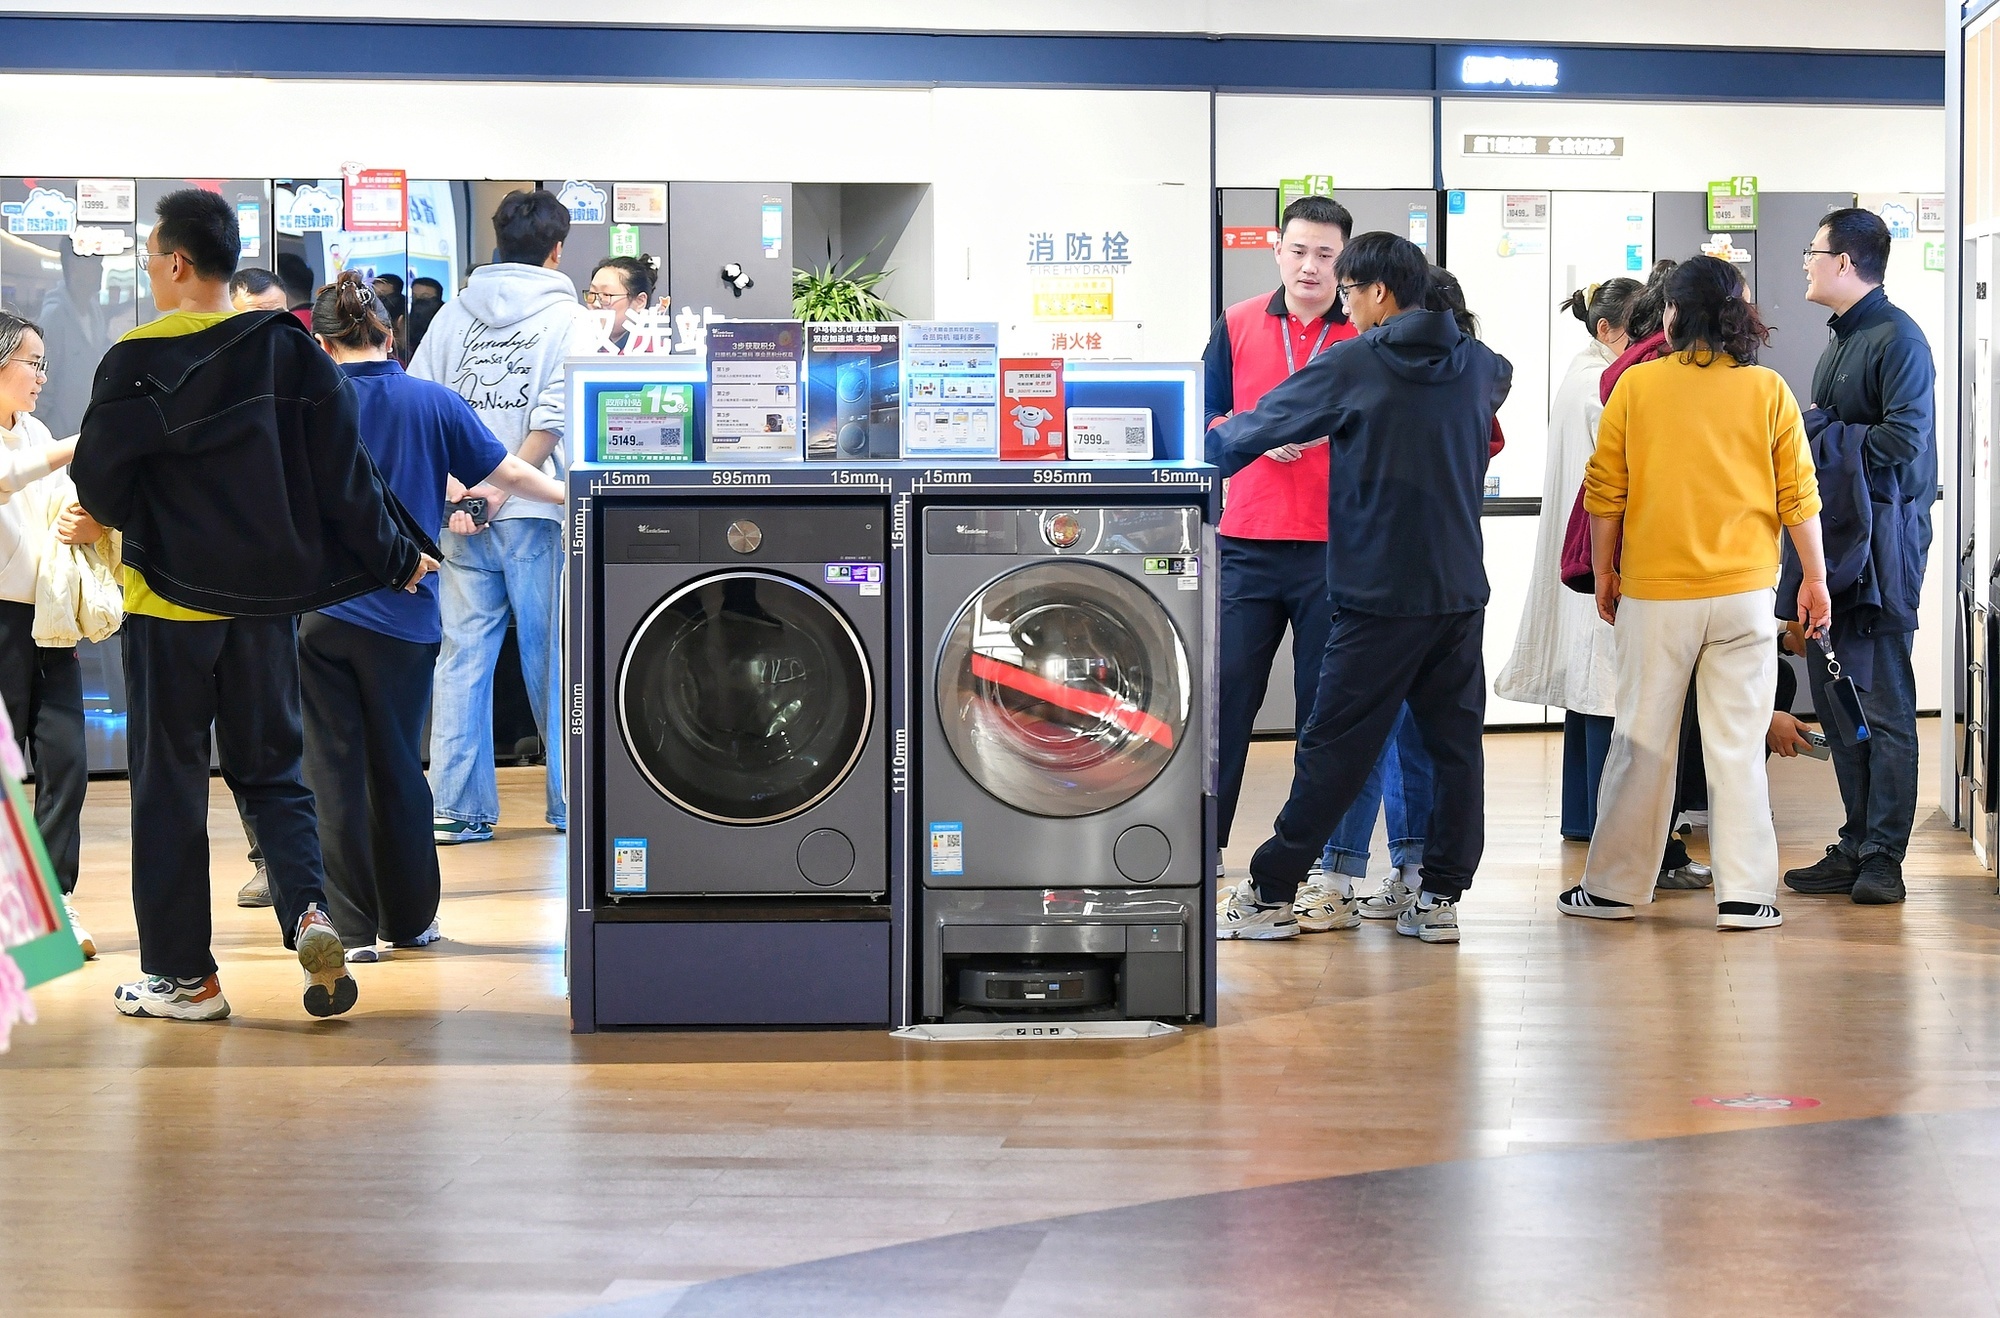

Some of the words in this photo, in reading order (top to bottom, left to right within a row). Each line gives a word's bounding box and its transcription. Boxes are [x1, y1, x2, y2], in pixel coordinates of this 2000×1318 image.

[1408, 202, 1428, 211] Midea
[294, 214, 334, 228] 熊墩墩
[1028, 231, 1129, 261] 消防栓
[1030, 264, 1060, 275] FIRE
[1064, 264, 1128, 275] HYDRANT
[922, 333, 951, 341] 会员购机
[952, 333, 981, 341] 福利多多
[1052, 332, 1102, 350] 消火栓
[732, 342, 776, 350] 3步获取积分
[605, 398, 642, 407] 政府补贴
[647, 386, 689, 413] 15%
[602, 471, 650, 485] 15mm
[712, 471, 771, 485] 595mm
[831, 470, 879, 484] 15mm
[924, 470, 972, 484] 15mm
[1033, 470, 1092, 484] 595mm
[1151, 469, 1199, 483] 15mm
[572, 511, 585, 557] 15mm
[892, 503, 905, 550] 15mm
[571, 682, 583, 736] 850mm
[892, 728, 906, 794] 1110mm
[1226, 909, 1241, 922] N
[1323, 903, 1335, 915] N
[1384, 894, 1397, 906] N
